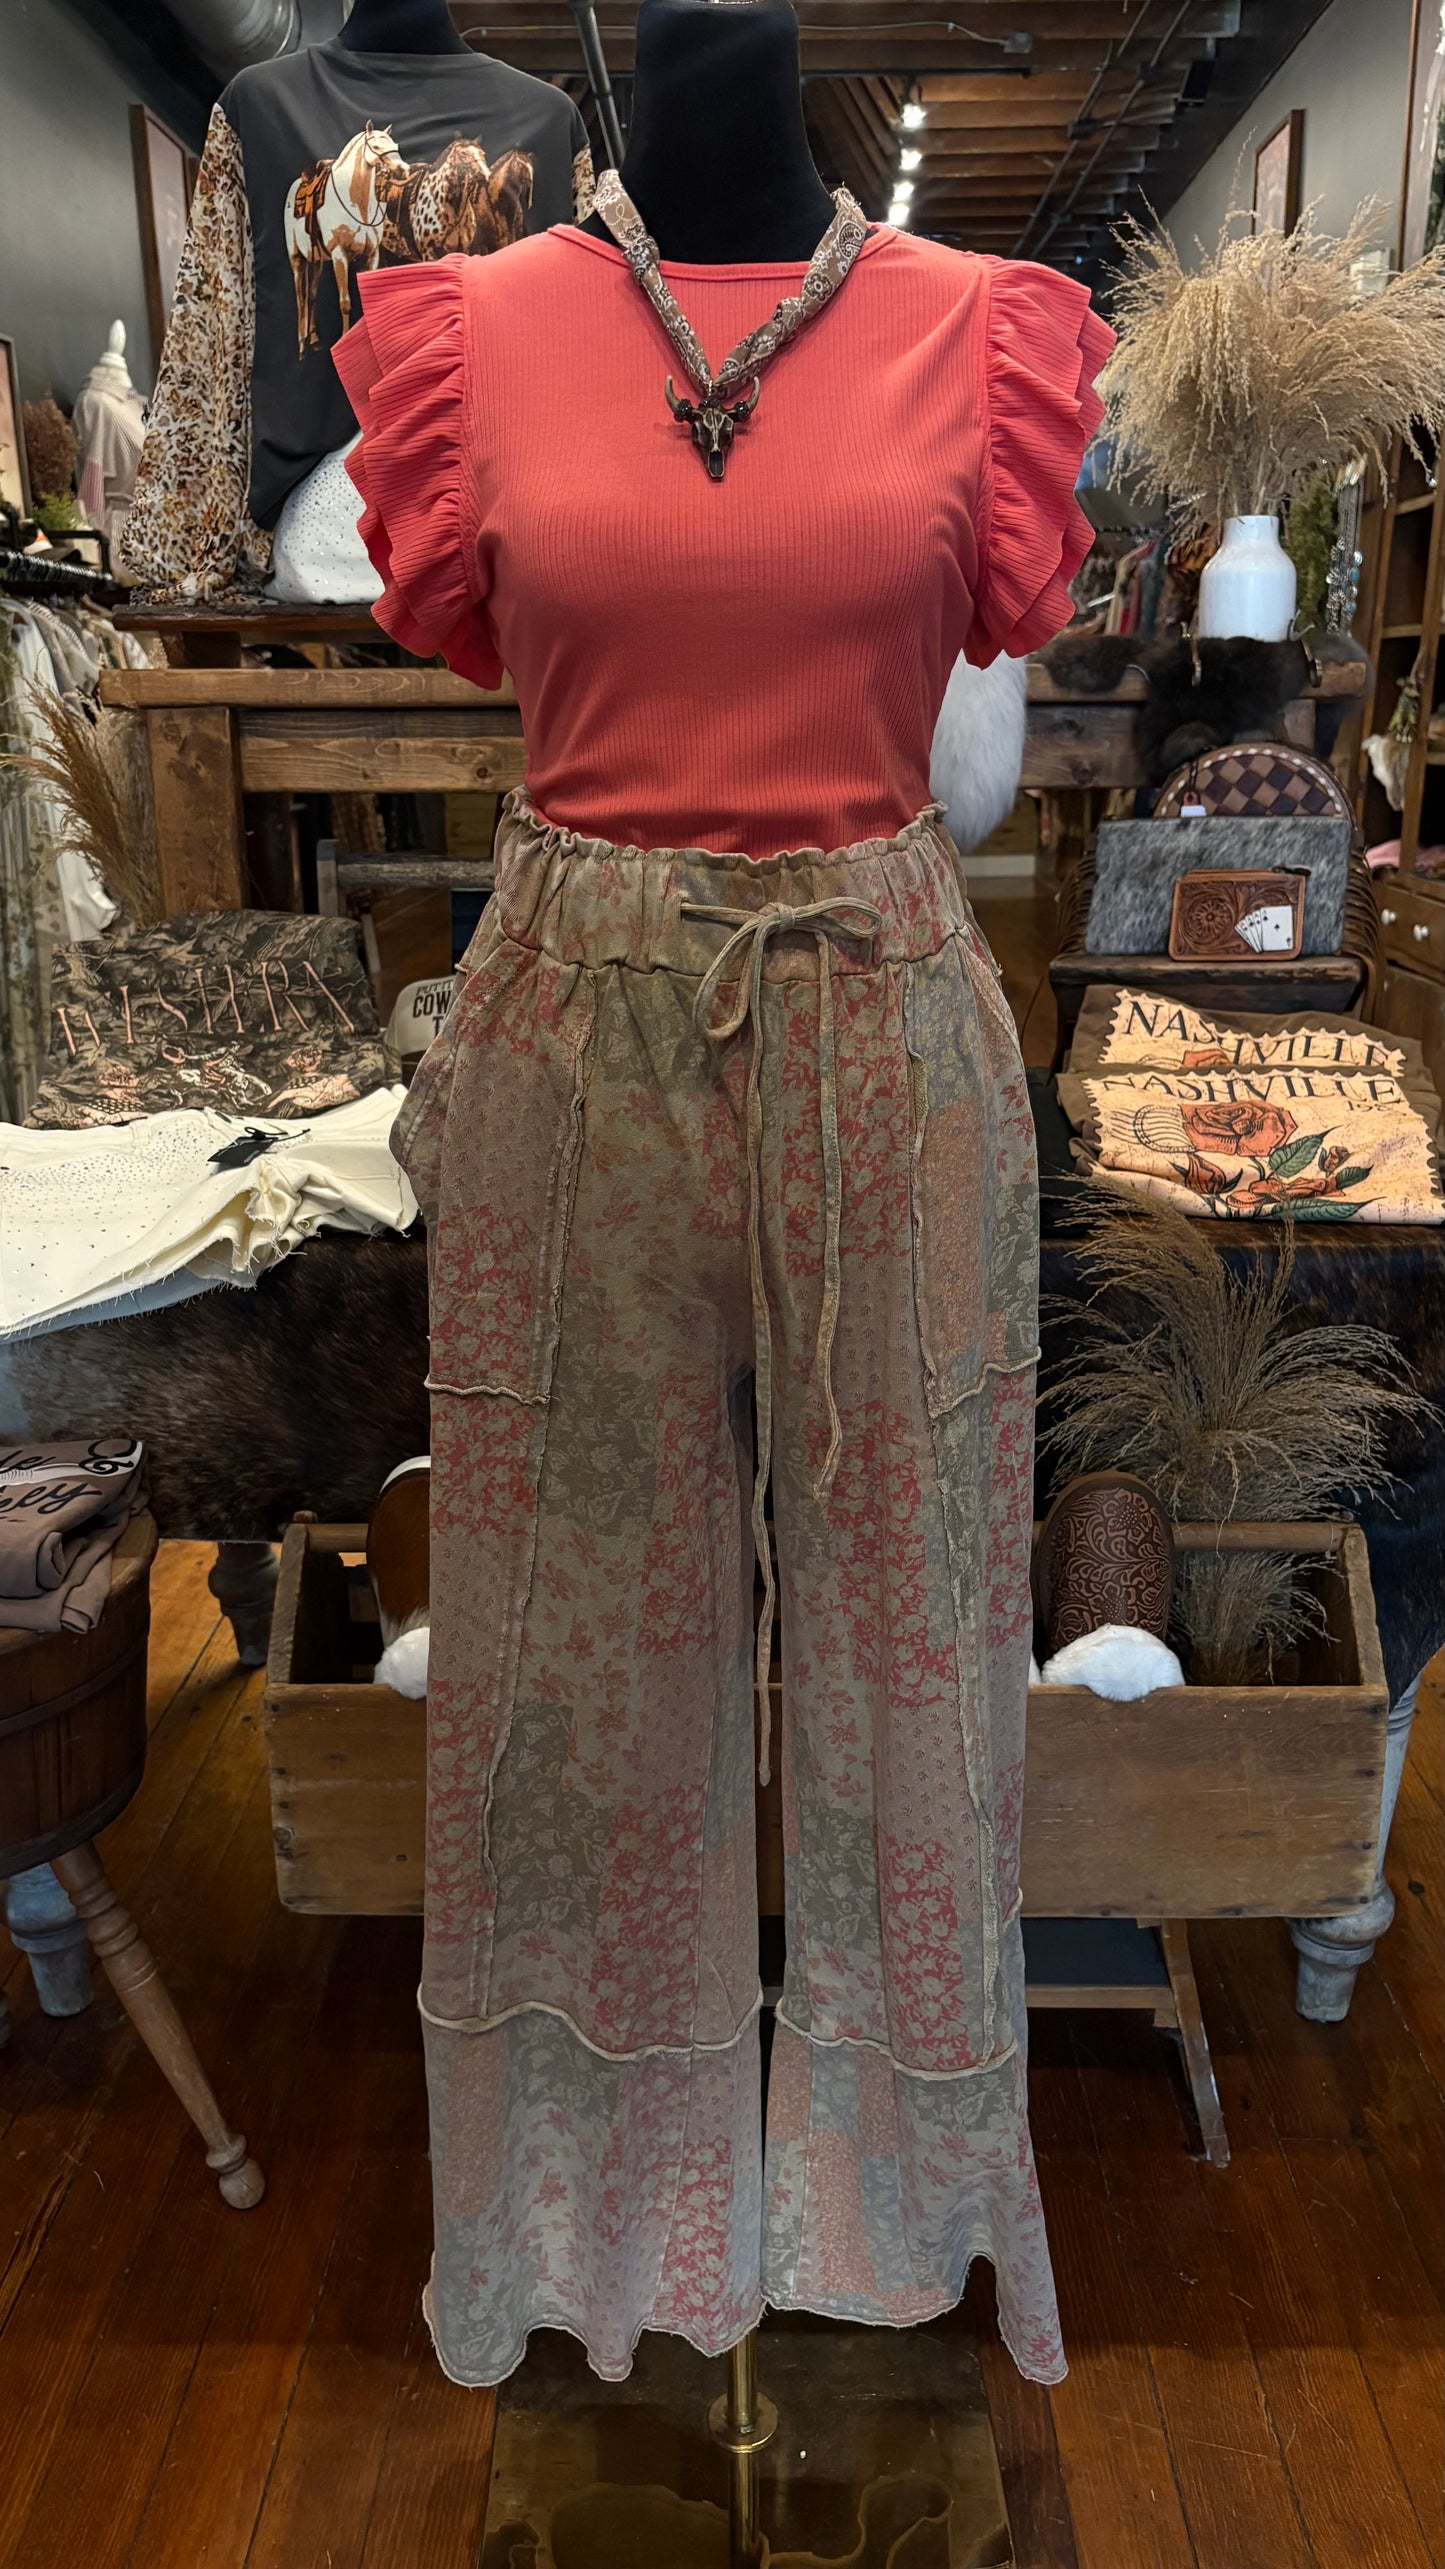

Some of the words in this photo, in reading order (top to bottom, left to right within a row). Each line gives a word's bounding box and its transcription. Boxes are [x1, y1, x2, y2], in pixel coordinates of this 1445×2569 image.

[416, 982, 441, 996] PUT
[1126, 1000, 1389, 1067] NASHVILLE
[1102, 1075, 1403, 1104] NASHVILLE
